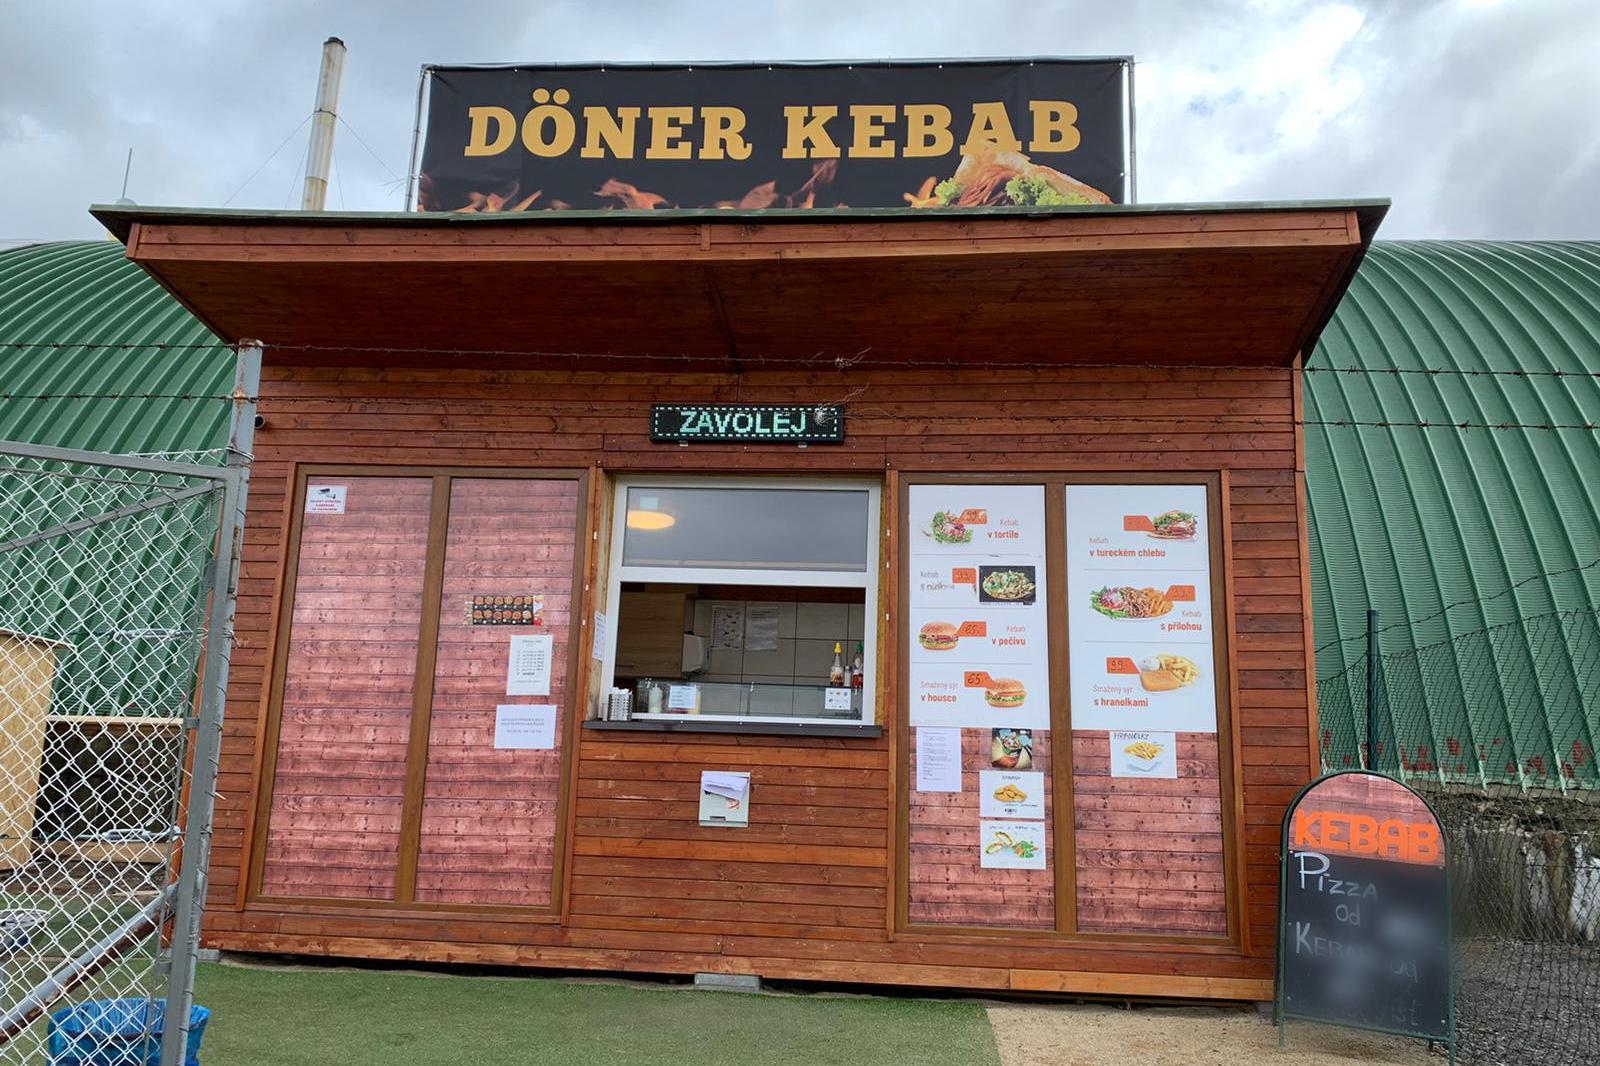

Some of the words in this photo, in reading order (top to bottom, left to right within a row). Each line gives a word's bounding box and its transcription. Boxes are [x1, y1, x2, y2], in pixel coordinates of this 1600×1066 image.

[463, 88, 752, 161] DÖNER
[782, 100, 1082, 160] KEBAB
[679, 410, 807, 434] ZAVOLEJ
[987, 531, 992, 539] v
[994, 530, 1019, 539] tortile
[1096, 548, 1136, 557] tureckém
[1138, 548, 1166, 558] chlebu
[1167, 622, 1202, 632] přílohou
[992, 637, 997, 646] v
[998, 636, 1026, 647] pečivu
[921, 694, 926, 702] v
[927, 692, 957, 703] housce
[1100, 697, 1149, 708] hranolkami
[1294, 808, 1441, 863] KEBAB
